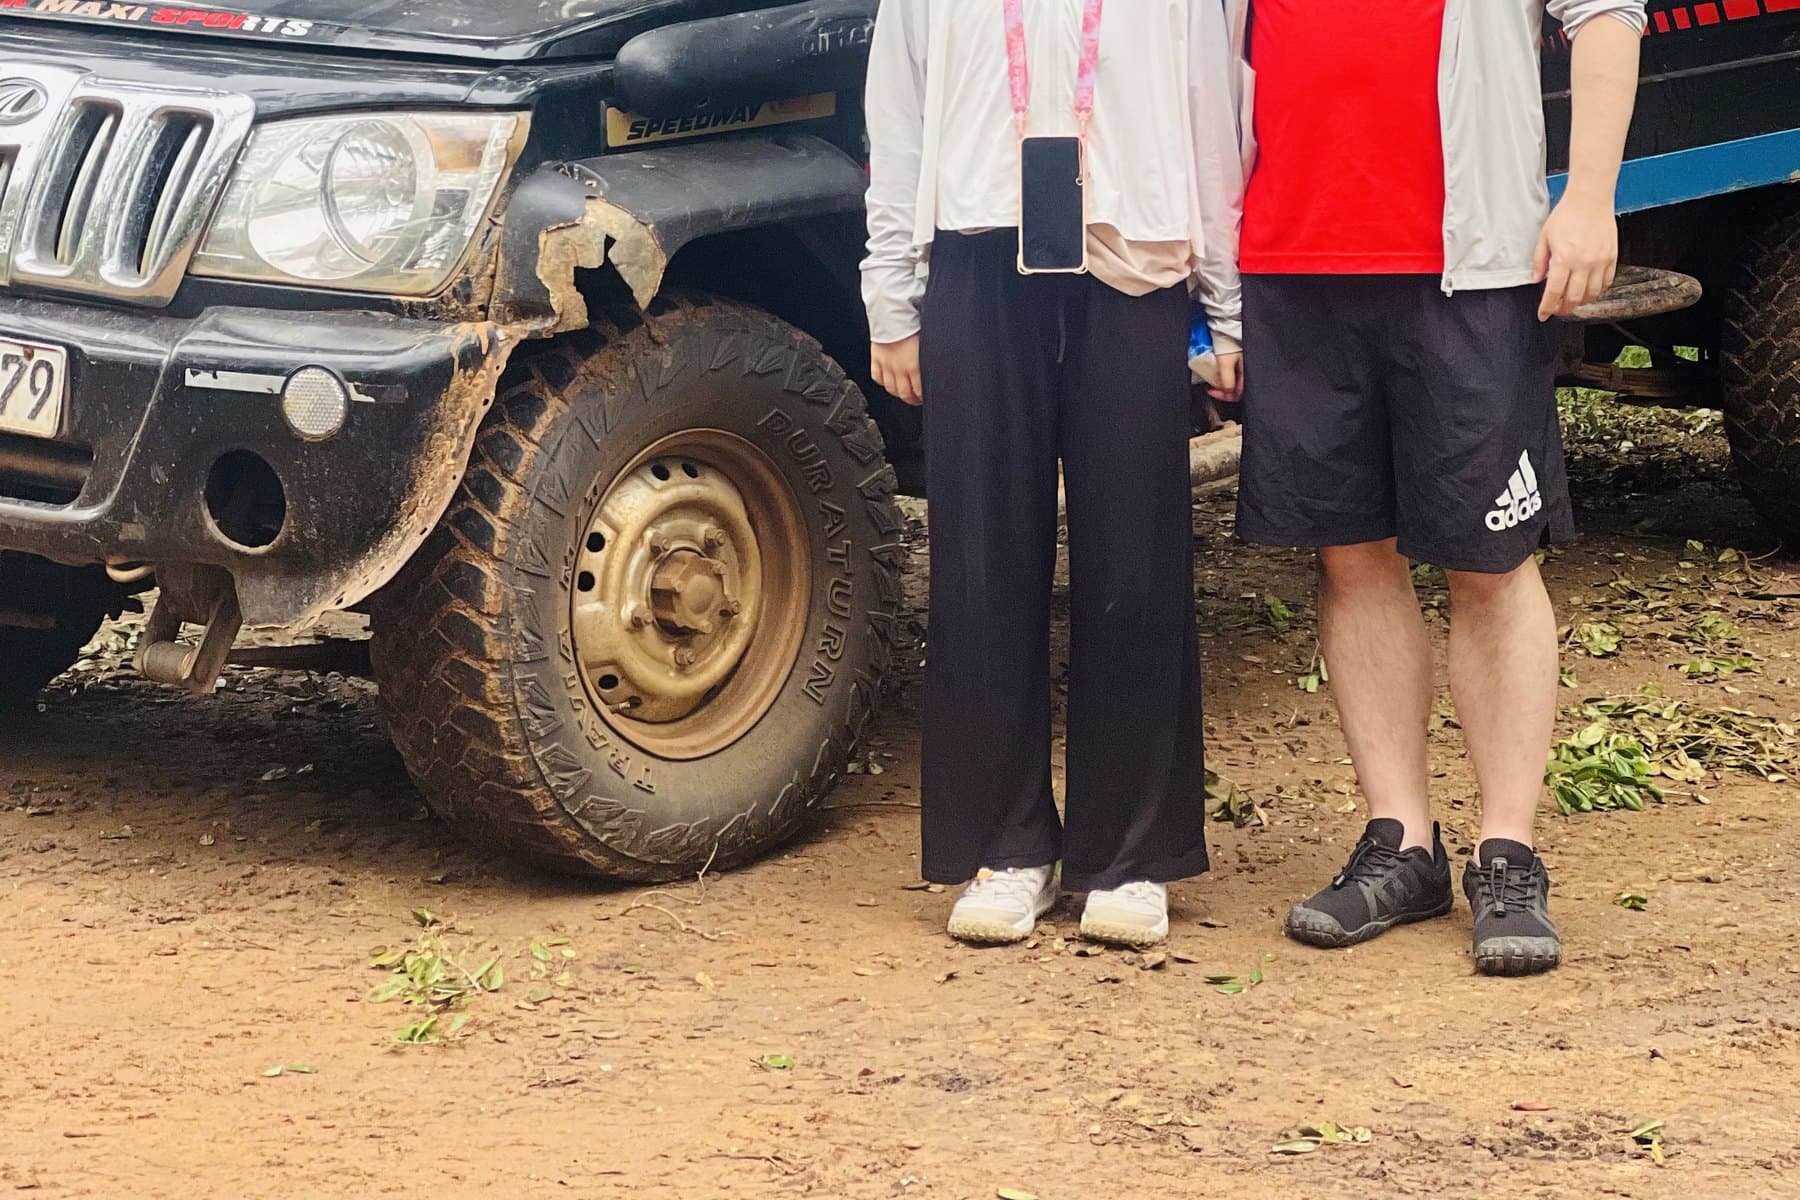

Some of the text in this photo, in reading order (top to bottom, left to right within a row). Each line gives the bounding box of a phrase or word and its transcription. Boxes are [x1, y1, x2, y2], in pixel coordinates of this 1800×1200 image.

[152, 8, 314, 36] SPORTS
[1485, 490, 1542, 531] adidas
[757, 408, 854, 704] DURATURN
